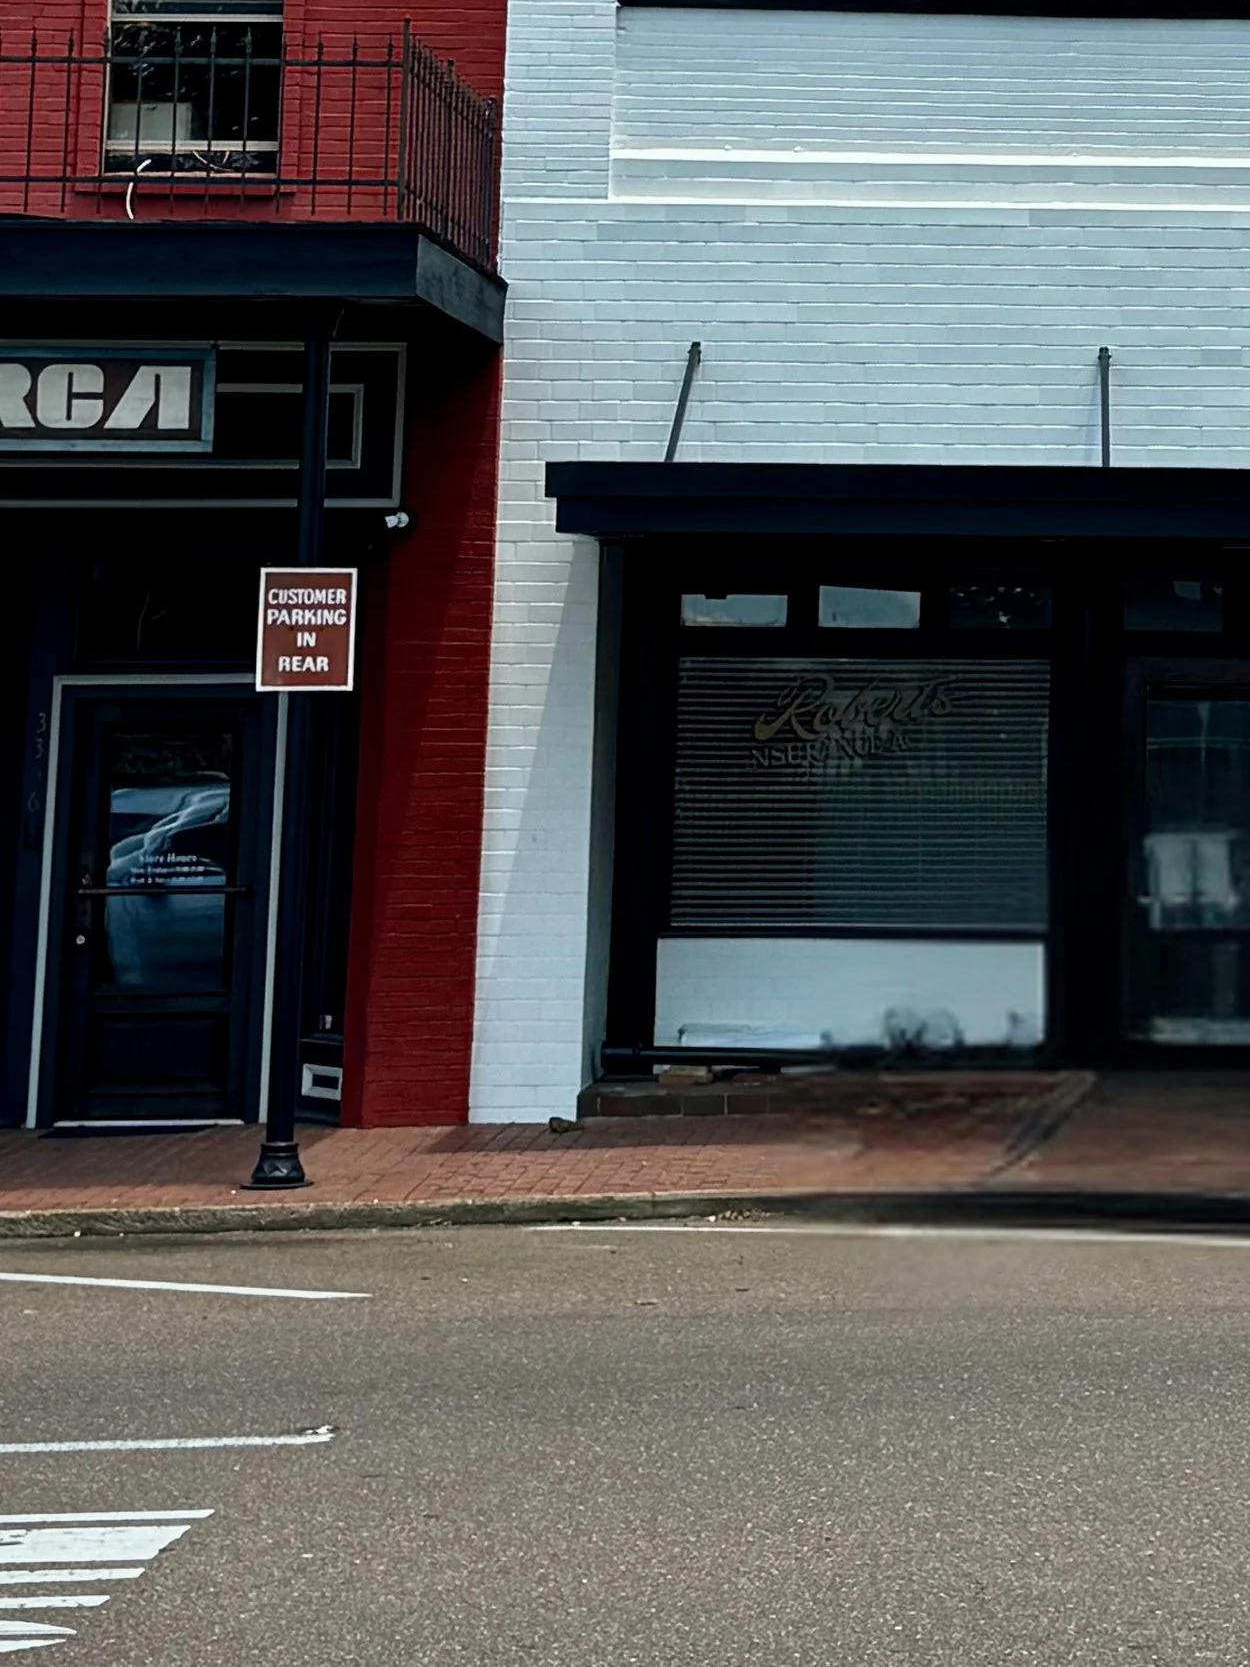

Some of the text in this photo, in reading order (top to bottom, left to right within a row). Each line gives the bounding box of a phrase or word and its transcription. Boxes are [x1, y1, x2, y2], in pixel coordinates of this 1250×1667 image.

[268, 588, 347, 605] CUSTOMER
[266, 609, 348, 626] PARKING
[296, 632, 317, 647] IN
[278, 656, 329, 672] REAR
[752, 673, 957, 741] Roberts
